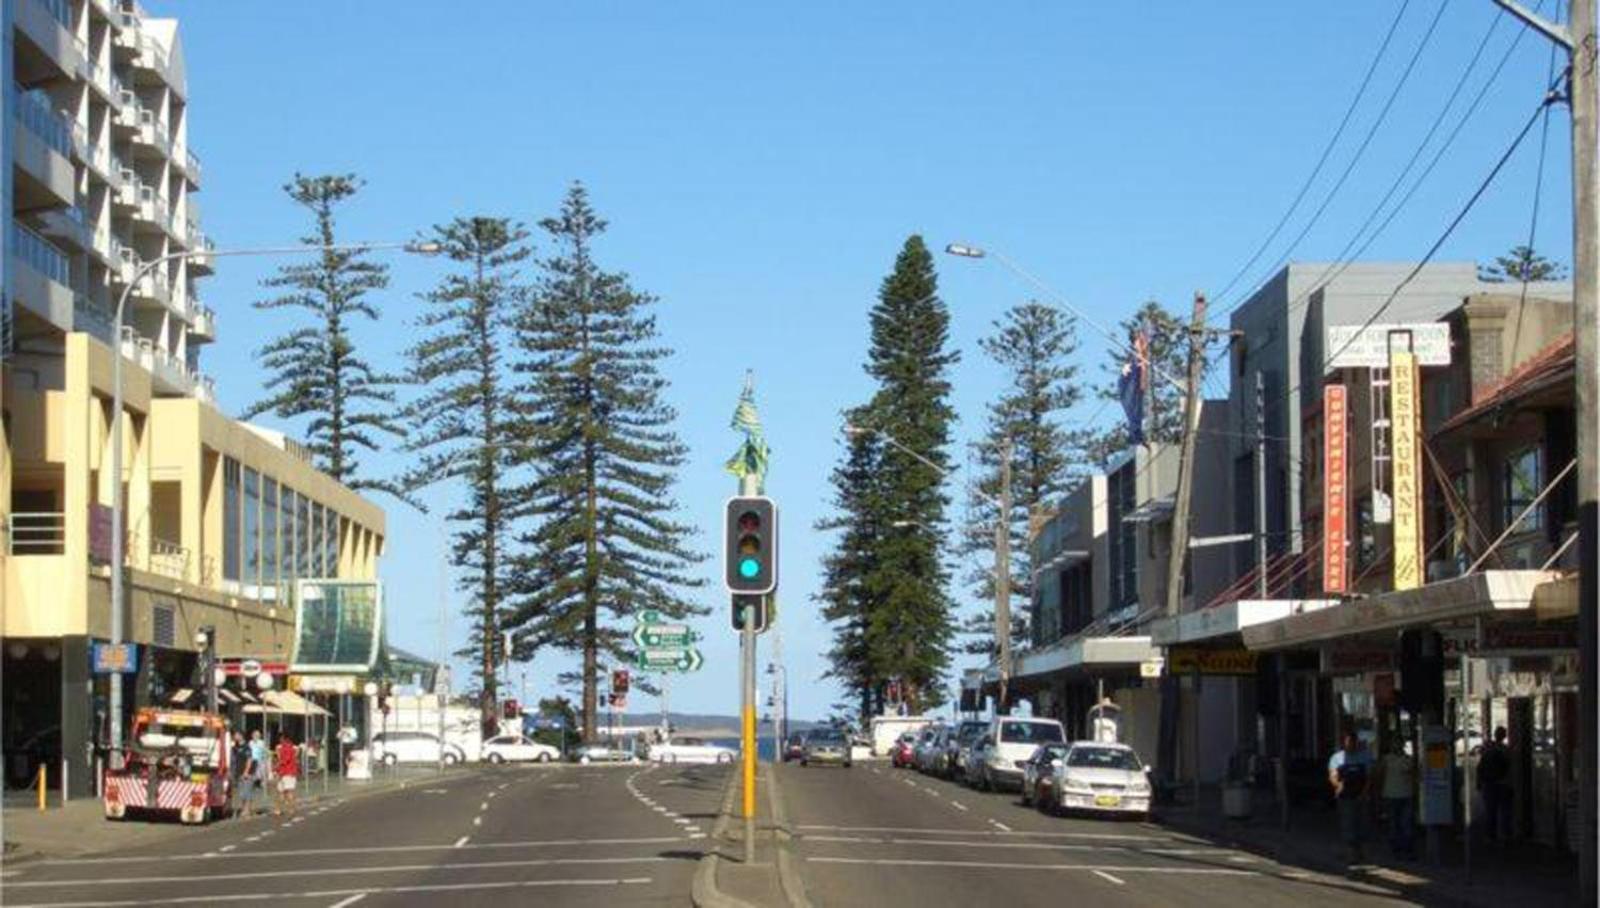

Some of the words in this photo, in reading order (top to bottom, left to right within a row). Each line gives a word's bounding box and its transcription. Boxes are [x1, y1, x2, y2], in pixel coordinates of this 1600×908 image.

[1329, 388, 1344, 516] CONVENIENCE
[1394, 365, 1412, 526] RESTAURANT
[1328, 530, 1343, 589] STORE
